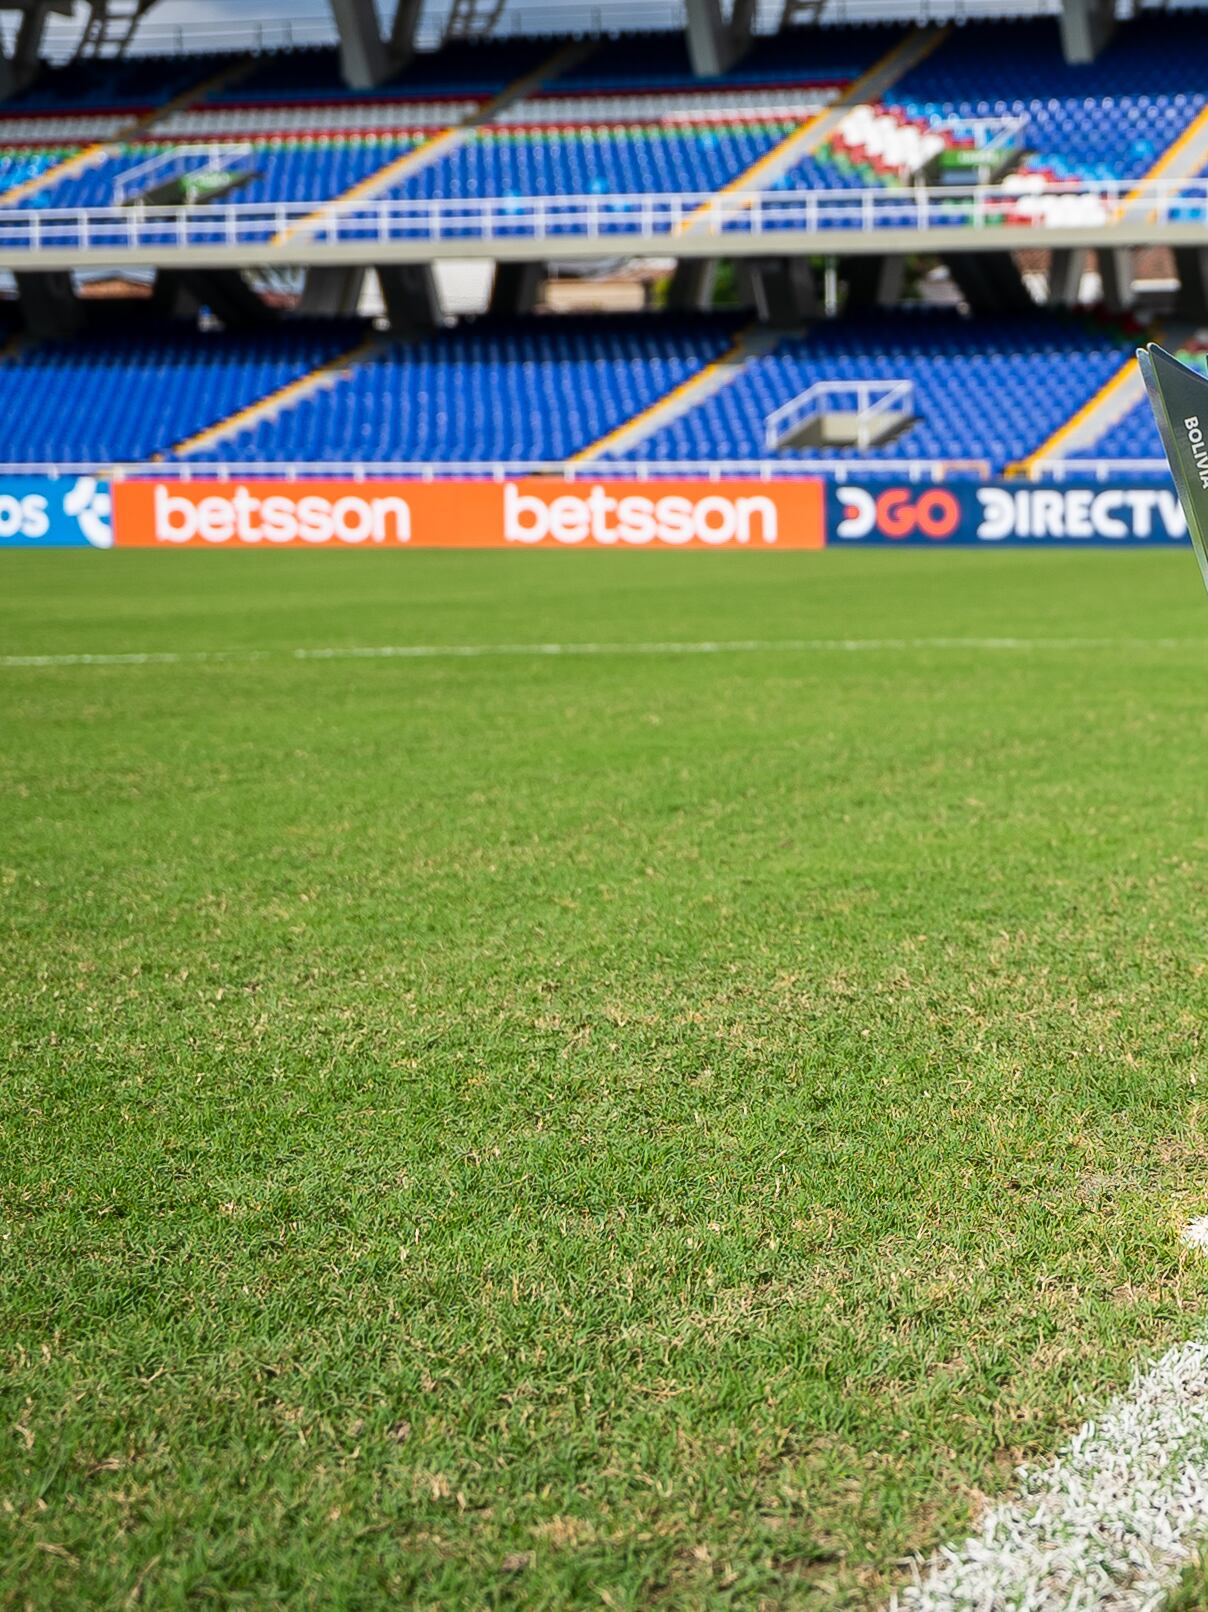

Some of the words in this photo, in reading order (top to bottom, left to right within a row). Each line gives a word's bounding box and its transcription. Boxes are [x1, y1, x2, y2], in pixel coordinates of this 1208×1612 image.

[154, 483, 411, 543] betsson
[503, 482, 778, 544] betsson
[836, 486, 960, 539] DGO
[976, 487, 1188, 540] DIRECTV
